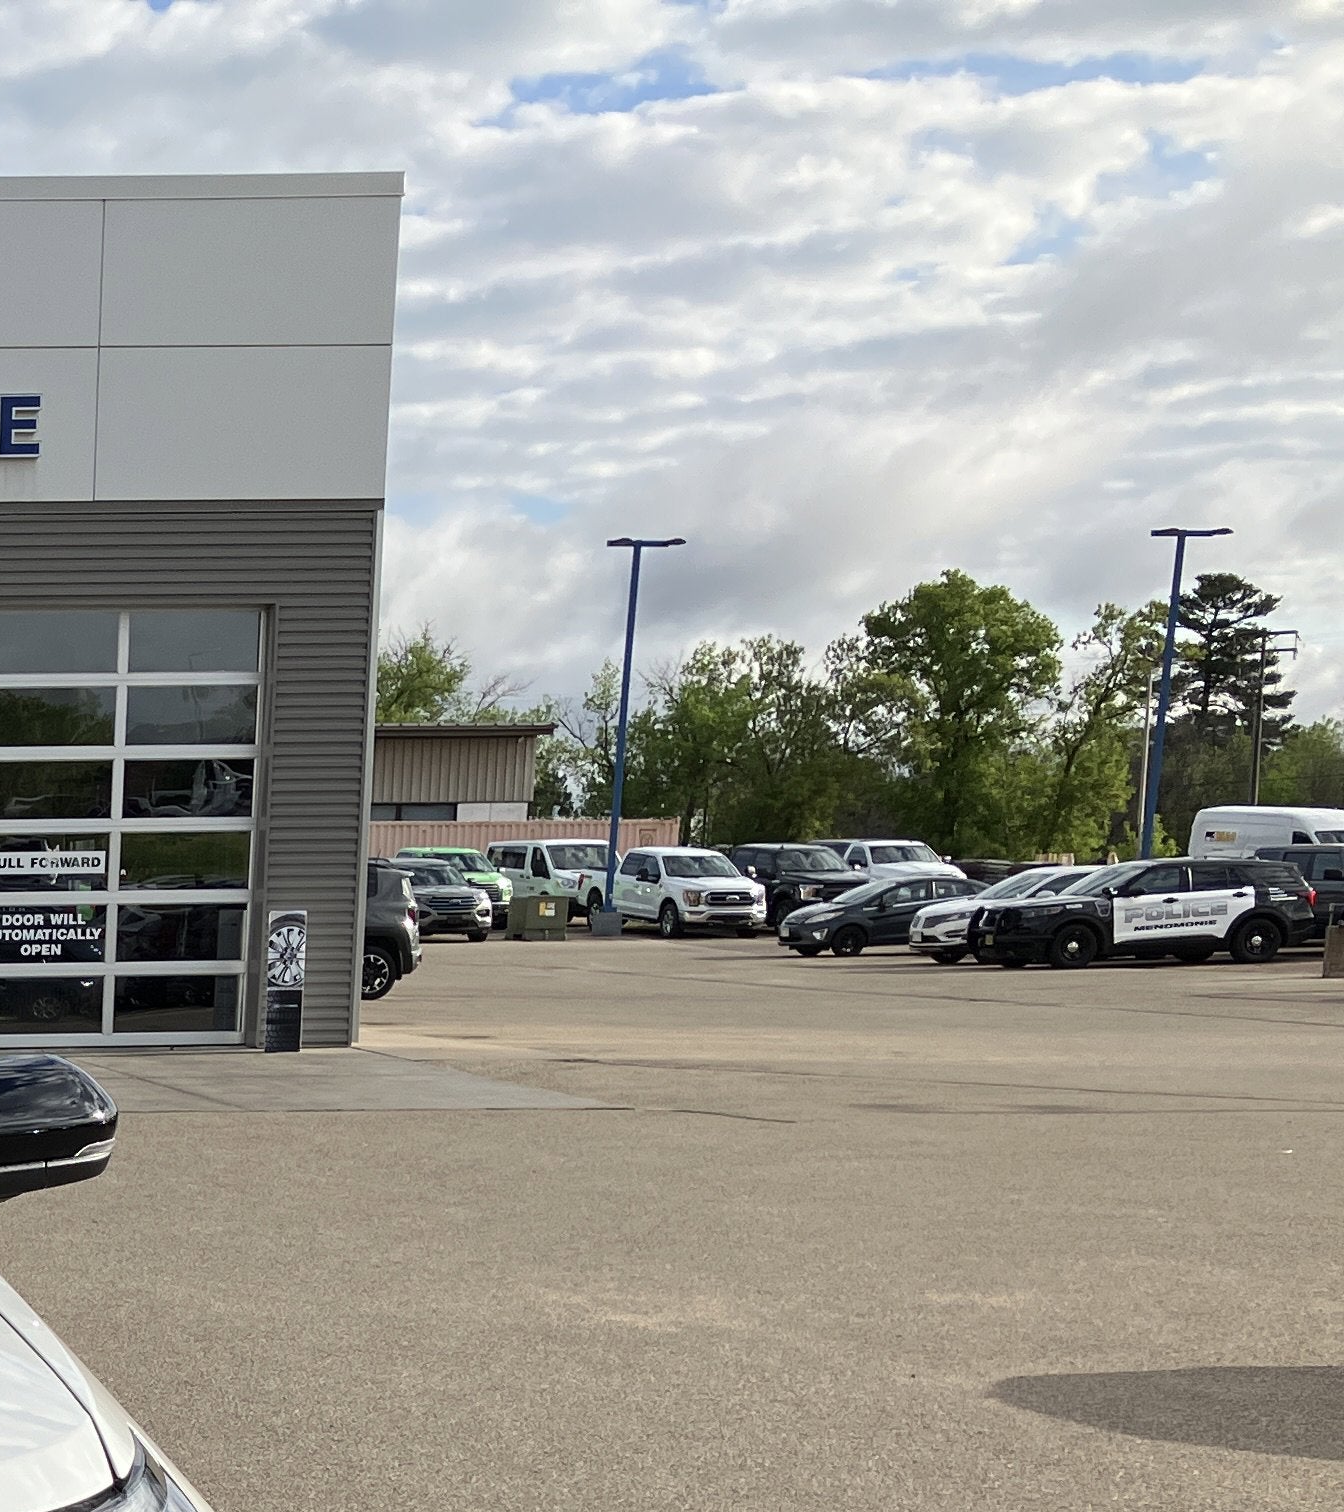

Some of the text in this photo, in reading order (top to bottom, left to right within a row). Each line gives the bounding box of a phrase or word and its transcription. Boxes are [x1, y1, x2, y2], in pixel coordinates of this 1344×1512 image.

[1124, 901, 1228, 924] POLICE
[2, 913, 86, 926] DOOR WILL
[1134, 920, 1217, 931] MENOMONIE
[20, 944, 62, 956] OPEN
